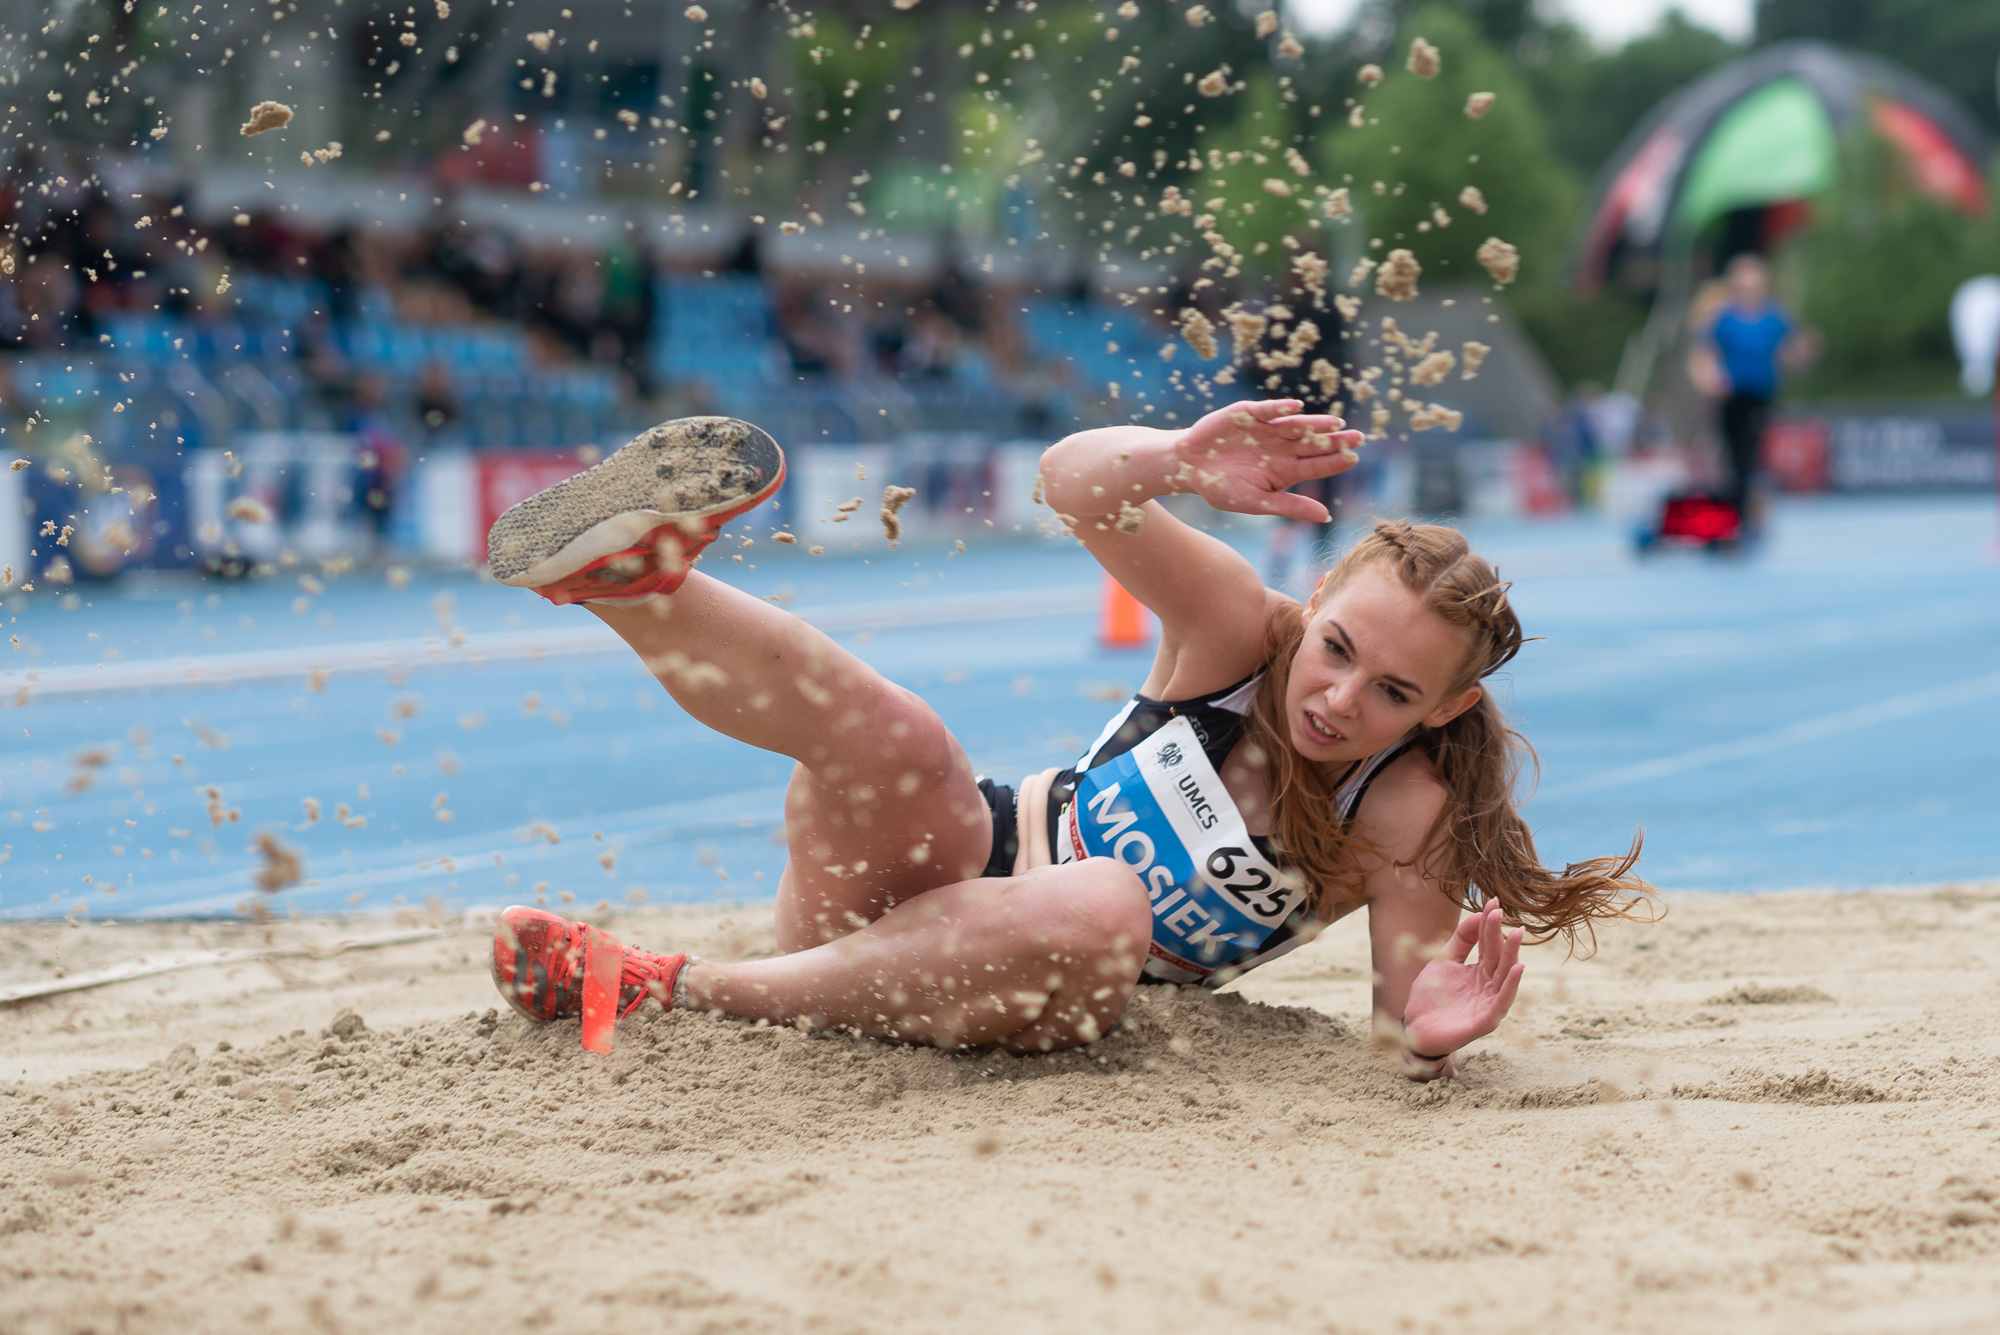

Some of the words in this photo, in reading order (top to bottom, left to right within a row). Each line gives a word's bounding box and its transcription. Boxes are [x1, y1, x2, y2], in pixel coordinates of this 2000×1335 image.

[1178, 773, 1219, 830] UMCS
[1087, 781, 1238, 956] MOSIEK
[1206, 846, 1295, 918] 625
